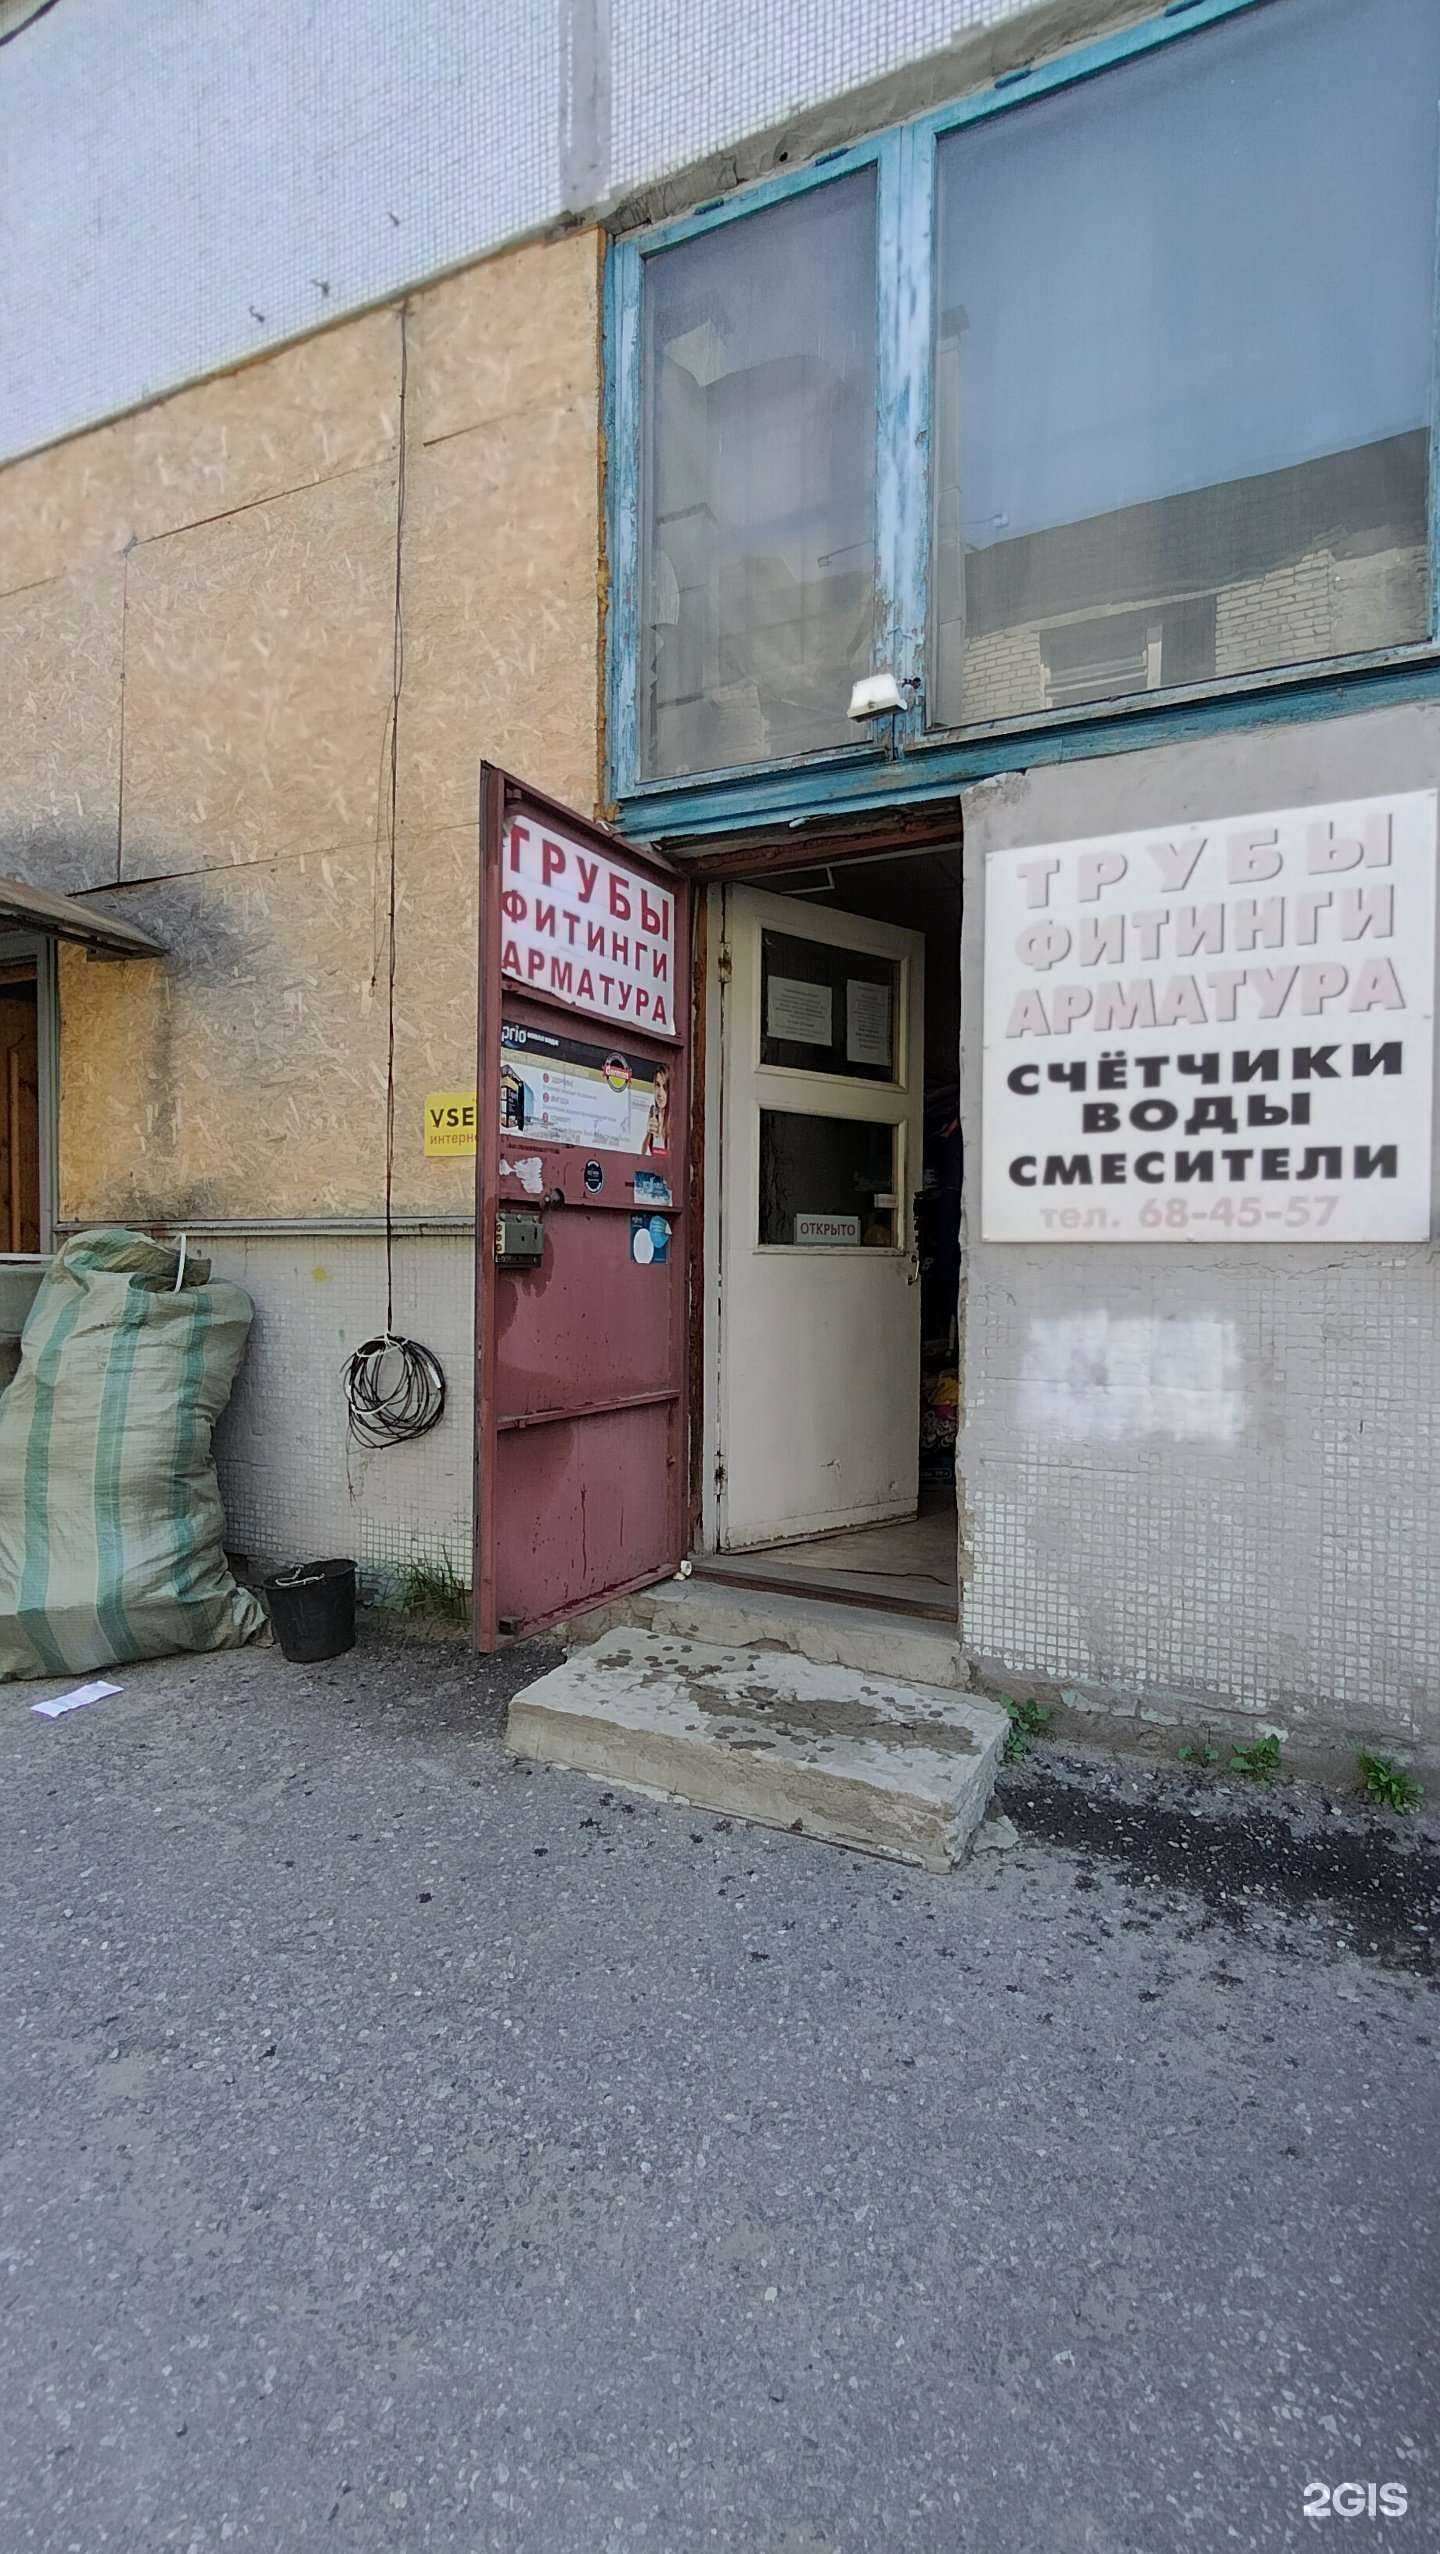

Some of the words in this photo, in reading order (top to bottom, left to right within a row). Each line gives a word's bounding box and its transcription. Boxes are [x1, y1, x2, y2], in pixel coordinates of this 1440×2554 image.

[1016, 813, 1394, 909] ТРУБЫ
[501, 889, 668, 983] ФИТИНГИ
[1015, 884, 1395, 972] ФИТИНГИ
[501, 940, 668, 1025] АРМАТУРА
[1005, 957, 1407, 1039] АРМАТУРА
[1007, 1041, 1403, 1096] СЧЁТЧИКИ
[429, 1134, 476, 1146] интерн
[1082, 1092, 1311, 1136] ВОДЫ
[1008, 1145, 1399, 1187] СМЕСИТЕЛИ
[800, 1222, 856, 1237] ОТКРЫТО
[1039, 1204, 1121, 1229] тел.
[1138, 1195, 1340, 1229] 68-45-57
